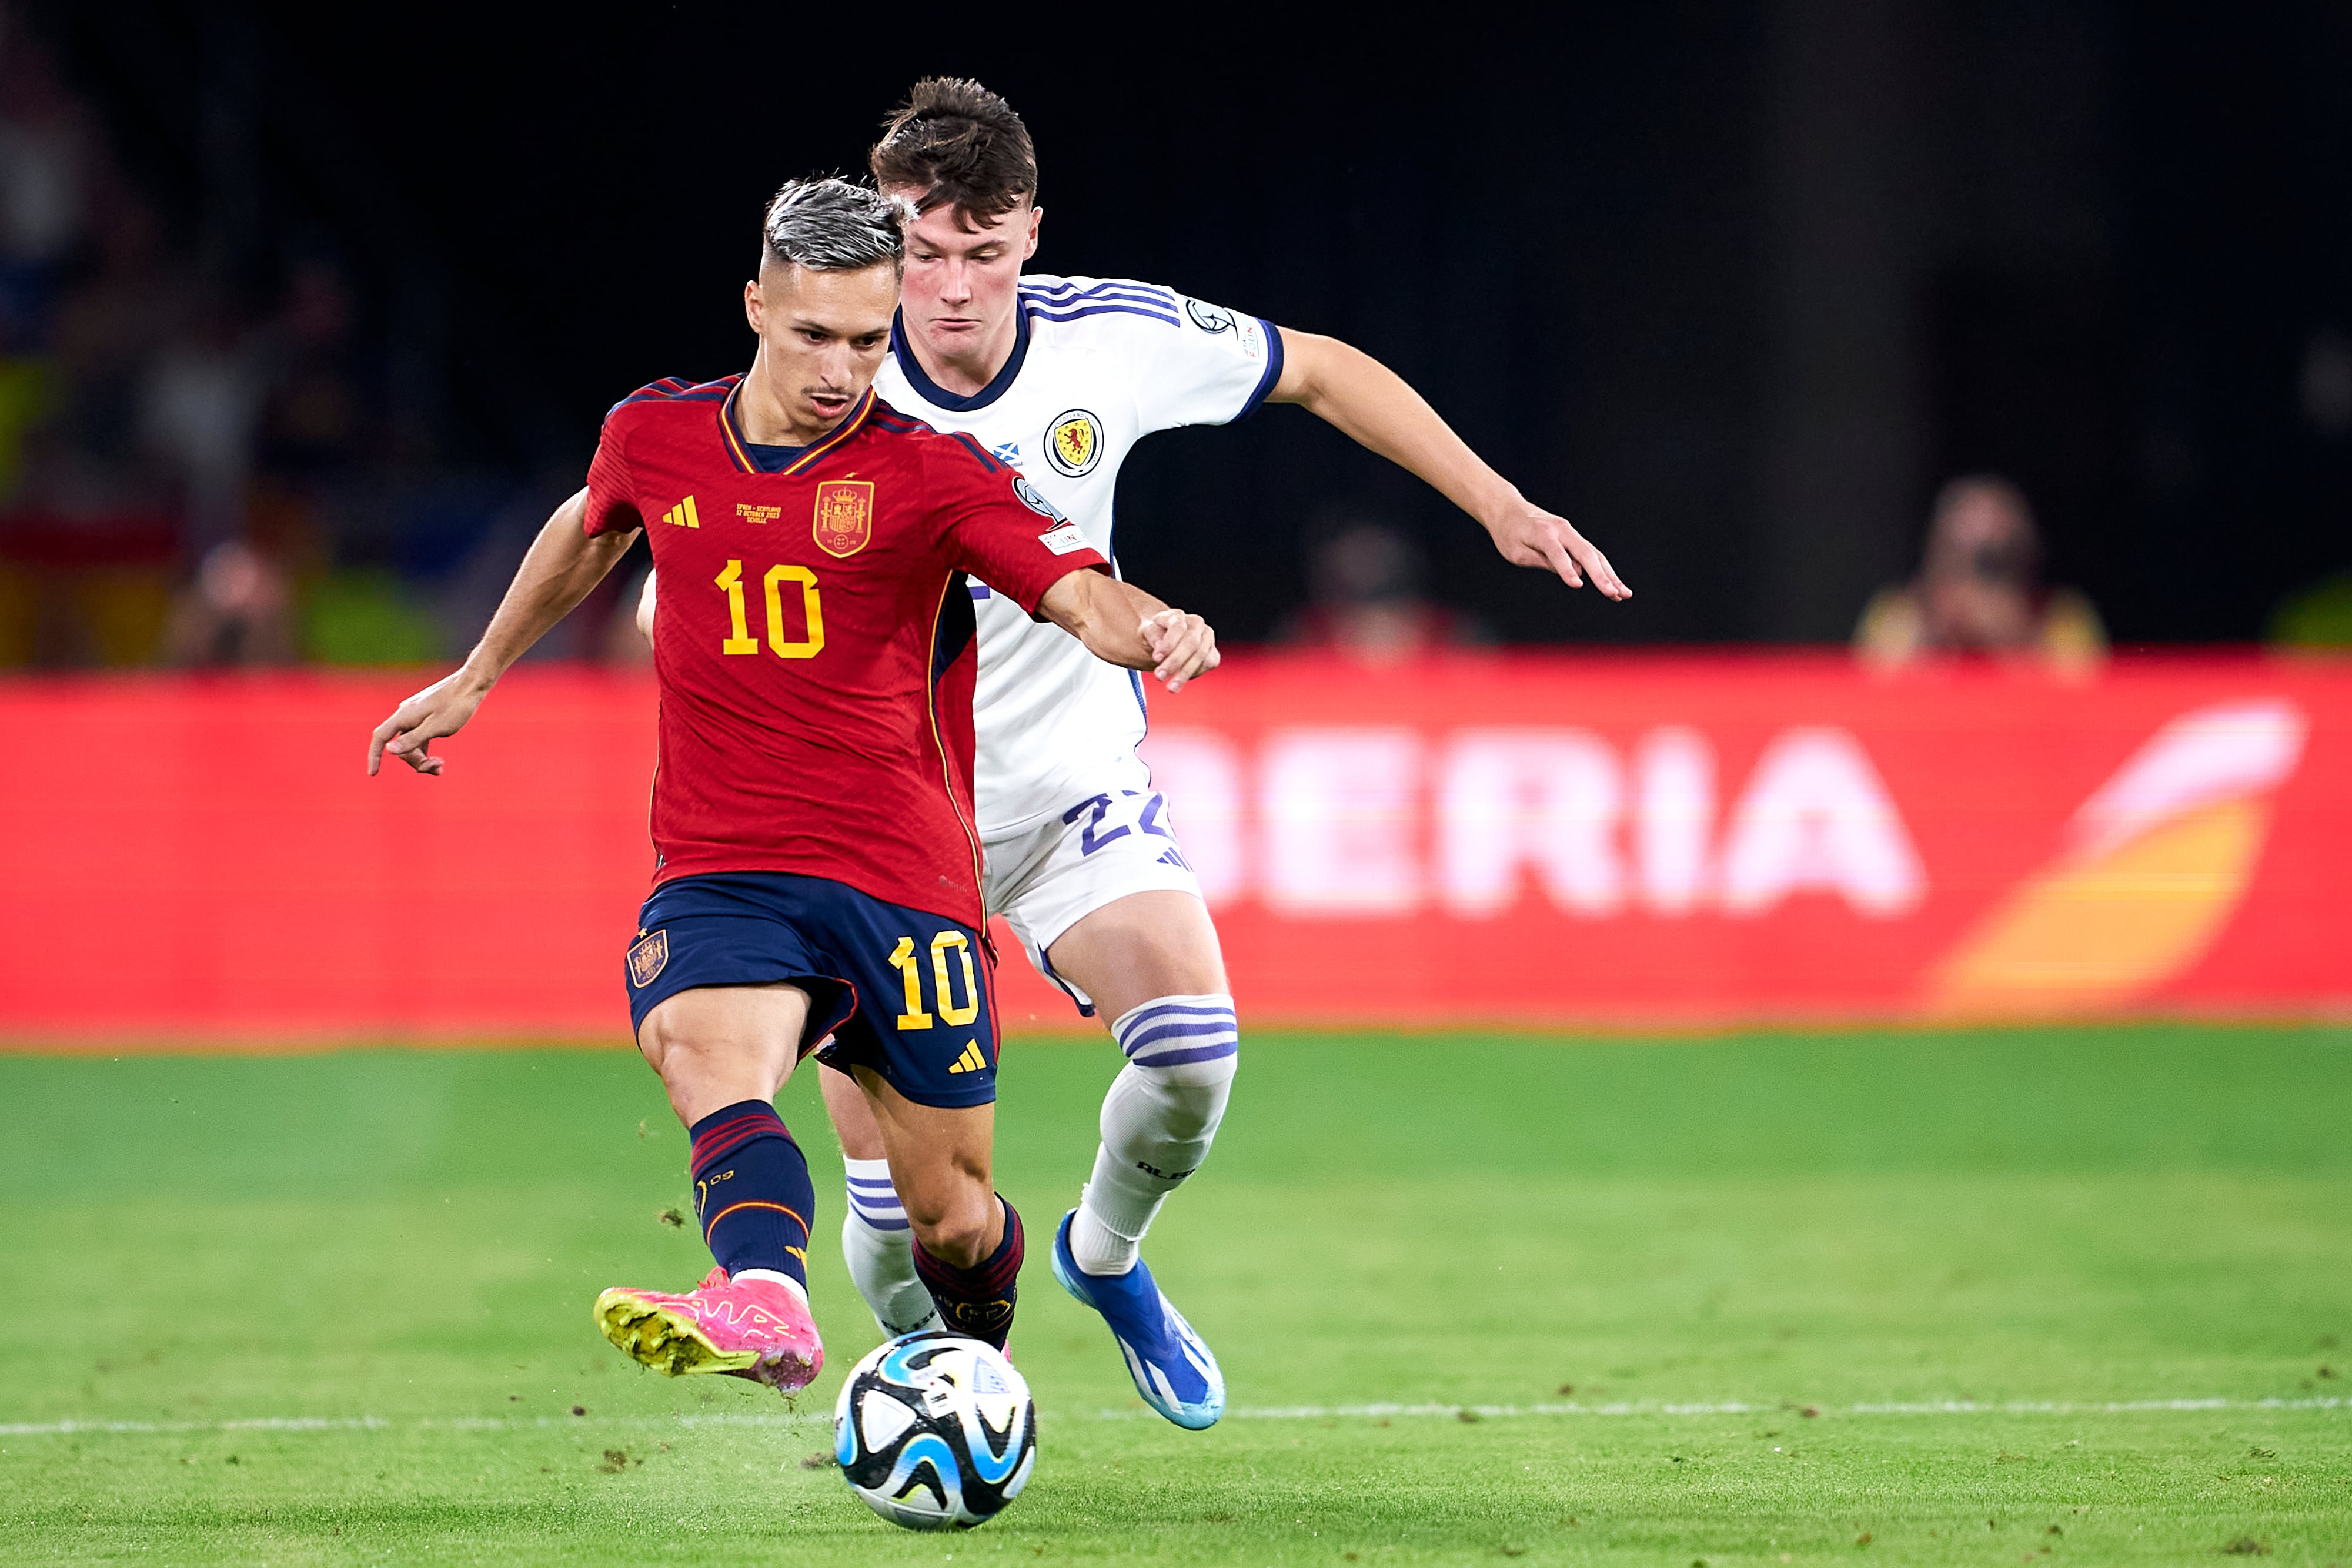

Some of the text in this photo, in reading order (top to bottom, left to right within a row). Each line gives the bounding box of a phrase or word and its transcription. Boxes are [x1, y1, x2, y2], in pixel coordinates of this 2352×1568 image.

[1056, 413, 1084, 425] SCOTLAND
[714, 559, 824, 658] 10
[1138, 726, 1927, 917] BERIA
[888, 930, 978, 1030] 10
